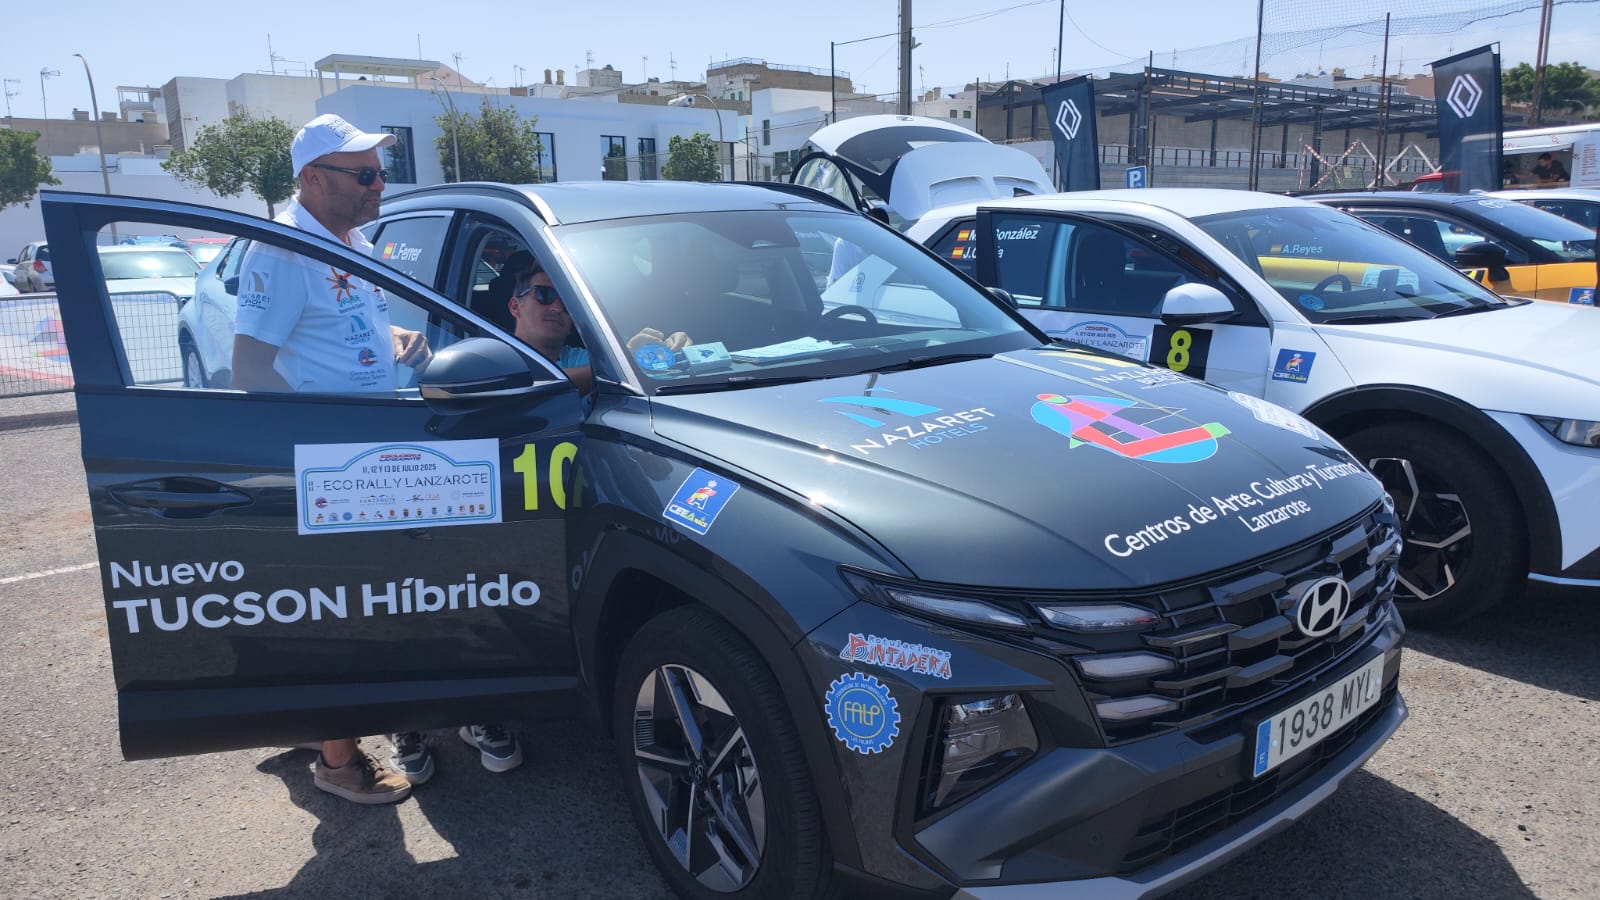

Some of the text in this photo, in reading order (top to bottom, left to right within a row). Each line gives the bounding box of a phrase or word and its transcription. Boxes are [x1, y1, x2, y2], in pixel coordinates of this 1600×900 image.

[1130, 170, 1142, 188] P
[1281, 245, 1323, 256] A.Reyes
[1167, 330, 1192, 372] 8
[850, 408, 995, 454] NAZARET
[908, 422, 988, 449] HOTELS
[324, 480, 352, 491] ECO
[356, 478, 402, 490] RALLY
[406, 473, 488, 488] LANZAROTE
[402, 464, 419, 472] JULIO
[420, 464, 436, 472] 2025
[1104, 462, 1361, 557] Centros de Arte, Cultura y Turismo
[1238, 499, 1311, 532] Lanzarote
[110, 560, 244, 588] Nuevo
[113, 573, 540, 634] TUCSON Híbrido
[1279, 692, 1334, 756] 1938
